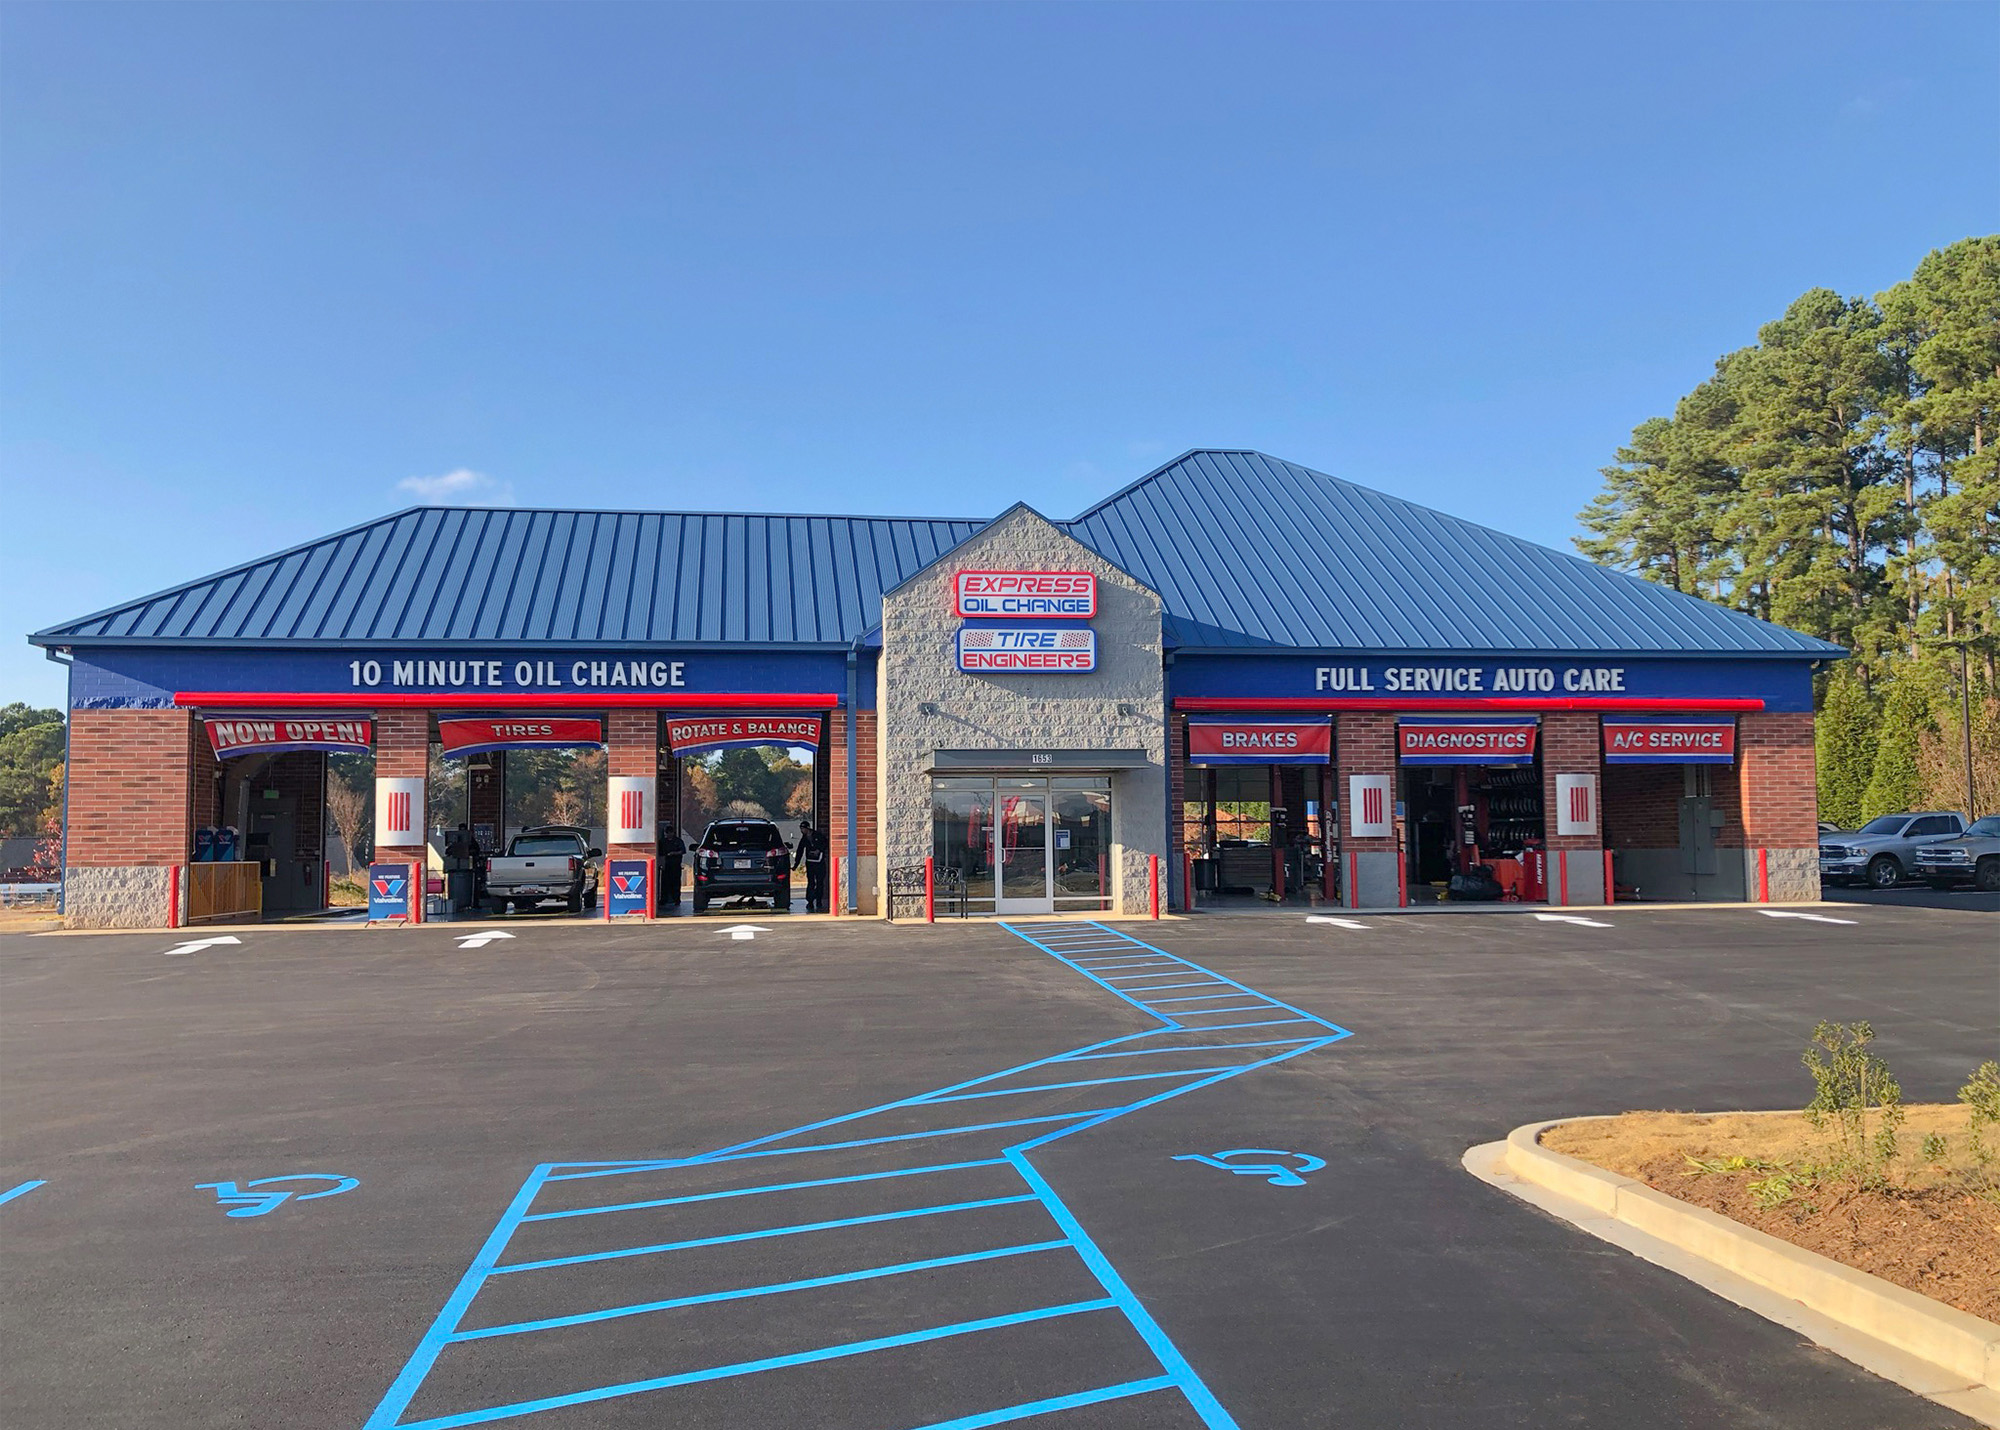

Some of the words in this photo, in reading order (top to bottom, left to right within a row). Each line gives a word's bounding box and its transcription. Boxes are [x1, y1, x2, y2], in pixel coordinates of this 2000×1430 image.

[964, 577, 1091, 593] EXPRESS
[964, 599, 998, 612] OIL
[1002, 599, 1090, 613] CHANGE
[998, 632, 1057, 647] TIRE
[963, 653, 1091, 668] ENGINEERS
[349, 660, 382, 686] 10
[393, 660, 503, 686] MINUTE
[514, 661, 561, 687] OIL
[571, 661, 685, 687] CHANGE
[1315, 667, 1375, 691] FULL
[1384, 667, 1484, 691] SERVICE
[1492, 668, 1555, 692] AUTO
[1563, 668, 1626, 692] CARE
[214, 721, 276, 747] NOW
[285, 721, 365, 743] OPEN!
[490, 724, 553, 737] TIRES
[672, 723, 727, 741] ROTATE
[731, 723, 743, 734] &
[747, 723, 817, 737] BALANCE
[1222, 732, 1298, 747] BRAKES
[1406, 733, 1527, 748] DIAGNOSTICS
[1613, 731, 1644, 749] A/C
[1648, 732, 1723, 747] SERVICE
